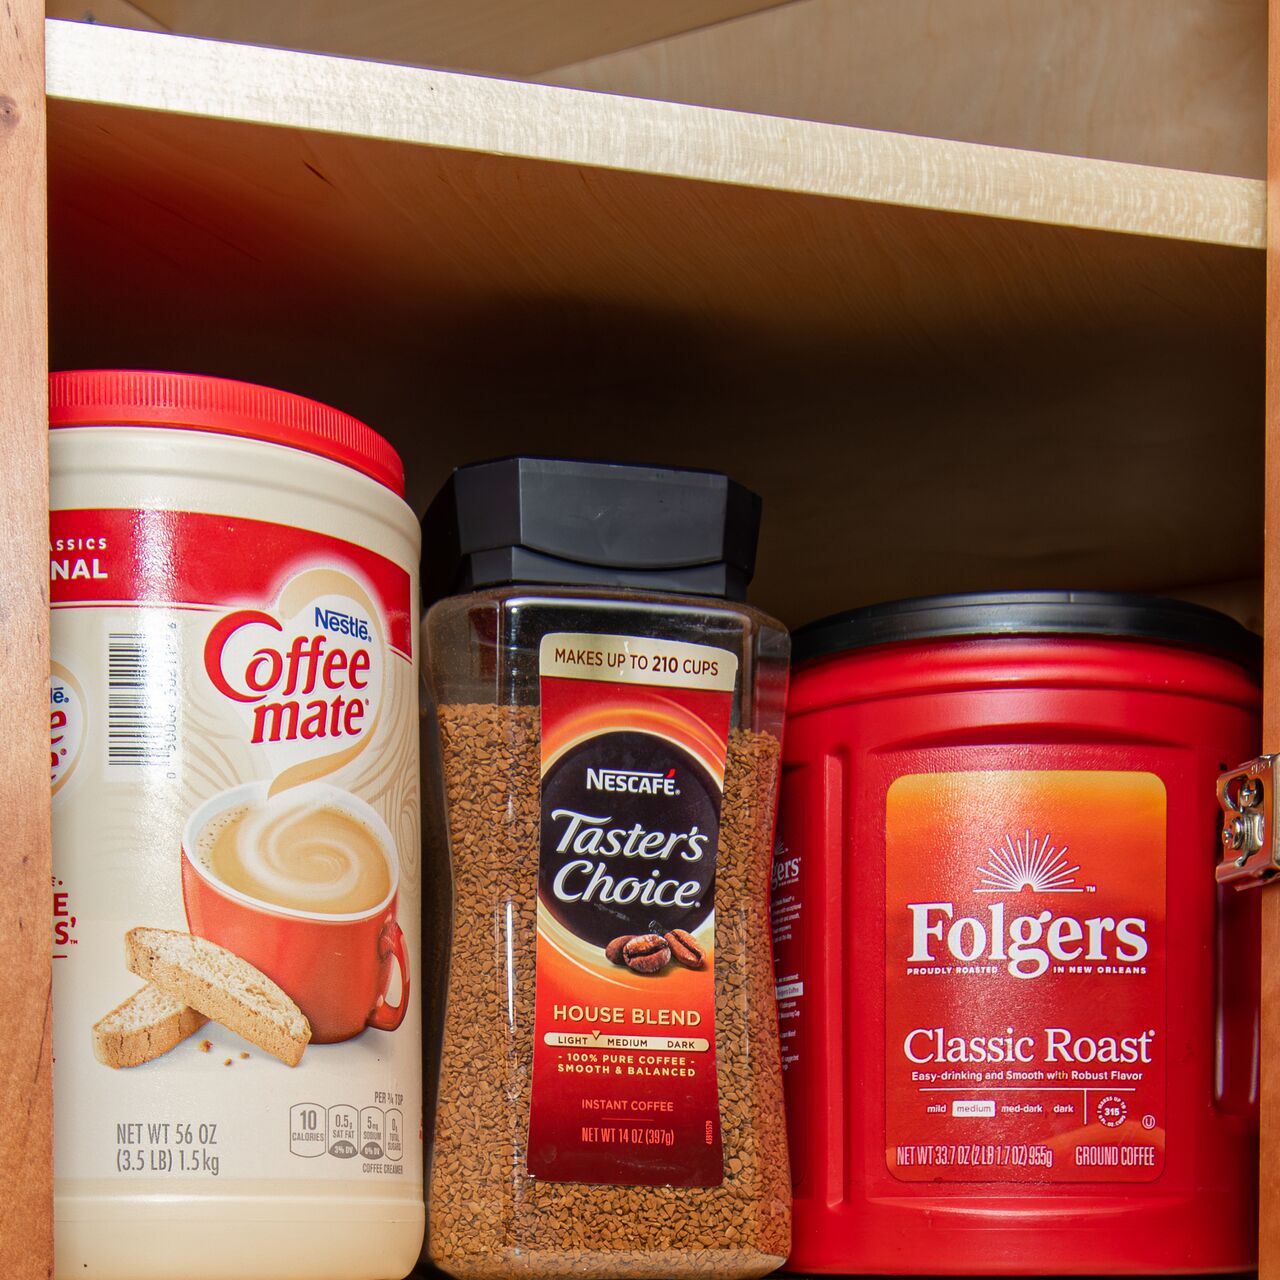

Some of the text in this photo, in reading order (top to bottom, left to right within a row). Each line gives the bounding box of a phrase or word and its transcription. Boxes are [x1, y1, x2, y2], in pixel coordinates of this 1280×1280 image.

[204, 610, 370, 703] Coffee
[554, 648, 719, 676] MAKES UP TO 210 CUPS
[251, 695, 365, 743] mate
[551, 808, 709, 862] Taster's
[552, 860, 702, 907] Choice
[906, 902, 1148, 979] Folgers
[907, 966, 1147, 975] PROUDLY ROASTED IN NEW ORLEANS
[553, 1004, 702, 1027] HOUSE BLEND
[558, 1036, 695, 1049] LIGHT MEDIUM DARK
[903, 1027, 1154, 1063] Classic Roast
[567, 1053, 686, 1065] 100% PURE COFFEE
[557, 1064, 696, 1077] SMOOTH & BALANCED
[911, 1070, 1143, 1083] Easy-drinking and Smooth with Robust Flavor
[582, 1099, 674, 1112] INSTANT COFFEE
[927, 1104, 947, 1113] mild
[956, 1104, 991, 1113] medium
[1001, 1104, 1043, 1113] med-dark
[1053, 1104, 1074, 1113] dark
[300, 1109, 317, 1130] 10
[117, 1123, 217, 1144] NET WT 56 OZ
[292, 1132, 324, 1142] CALORIES
[332, 1130, 355, 1139] SAT FAT
[582, 1127, 675, 1146] NET WT 14 OZ (397g)
[117, 1148, 144, 1172] (3.5
[151, 1148, 172, 1172] LB)
[897, 1146, 916, 1165] NET
[917, 1146, 933, 1165] WT
[935, 1145, 955, 1165] 33.7
[958, 1145, 970, 1165] OZ
[981, 1145, 994, 1165] LB
[996, 1145, 1010, 1165] 1.7
[1028, 1146, 1053, 1167] 955g
[1075, 1146, 1155, 1166] GROUND COFFEE
[362, 1163, 382, 1174] COFFEE
